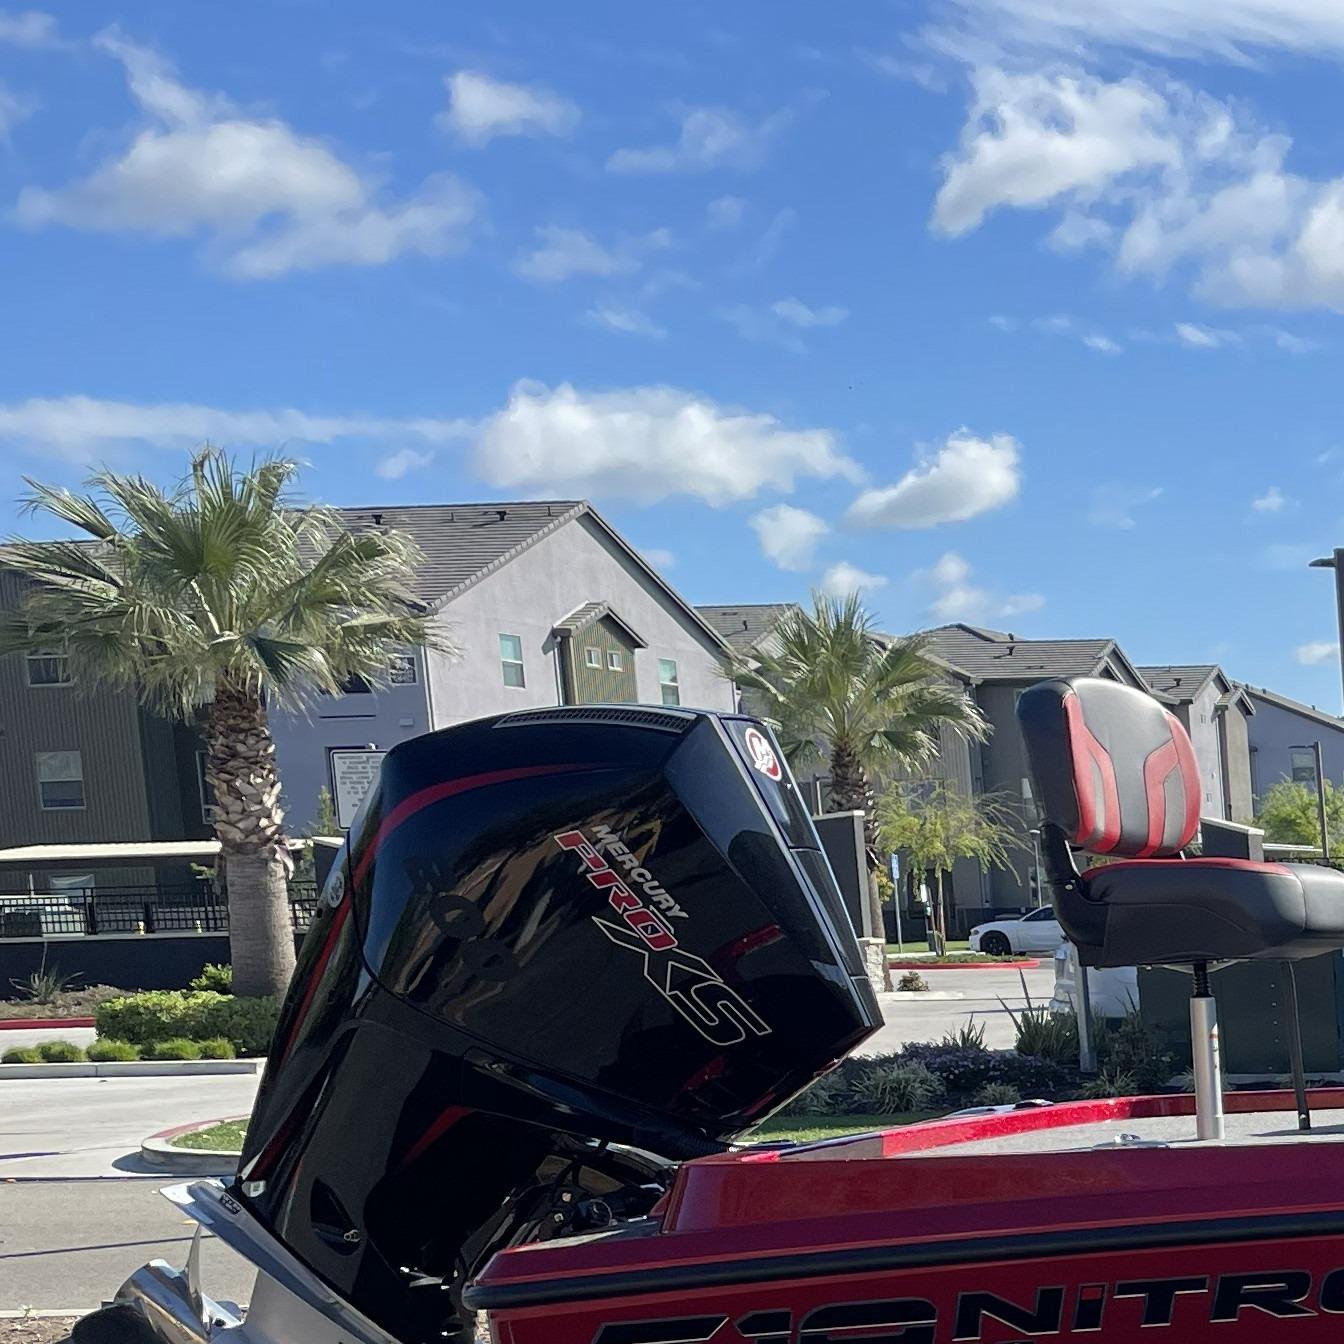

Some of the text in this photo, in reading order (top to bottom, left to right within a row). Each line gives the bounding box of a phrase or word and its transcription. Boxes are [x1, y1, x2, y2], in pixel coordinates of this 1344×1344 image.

[554, 830, 679, 952] PRO
[591, 824, 689, 919] MERCURY
[591, 904, 773, 1046] XS
